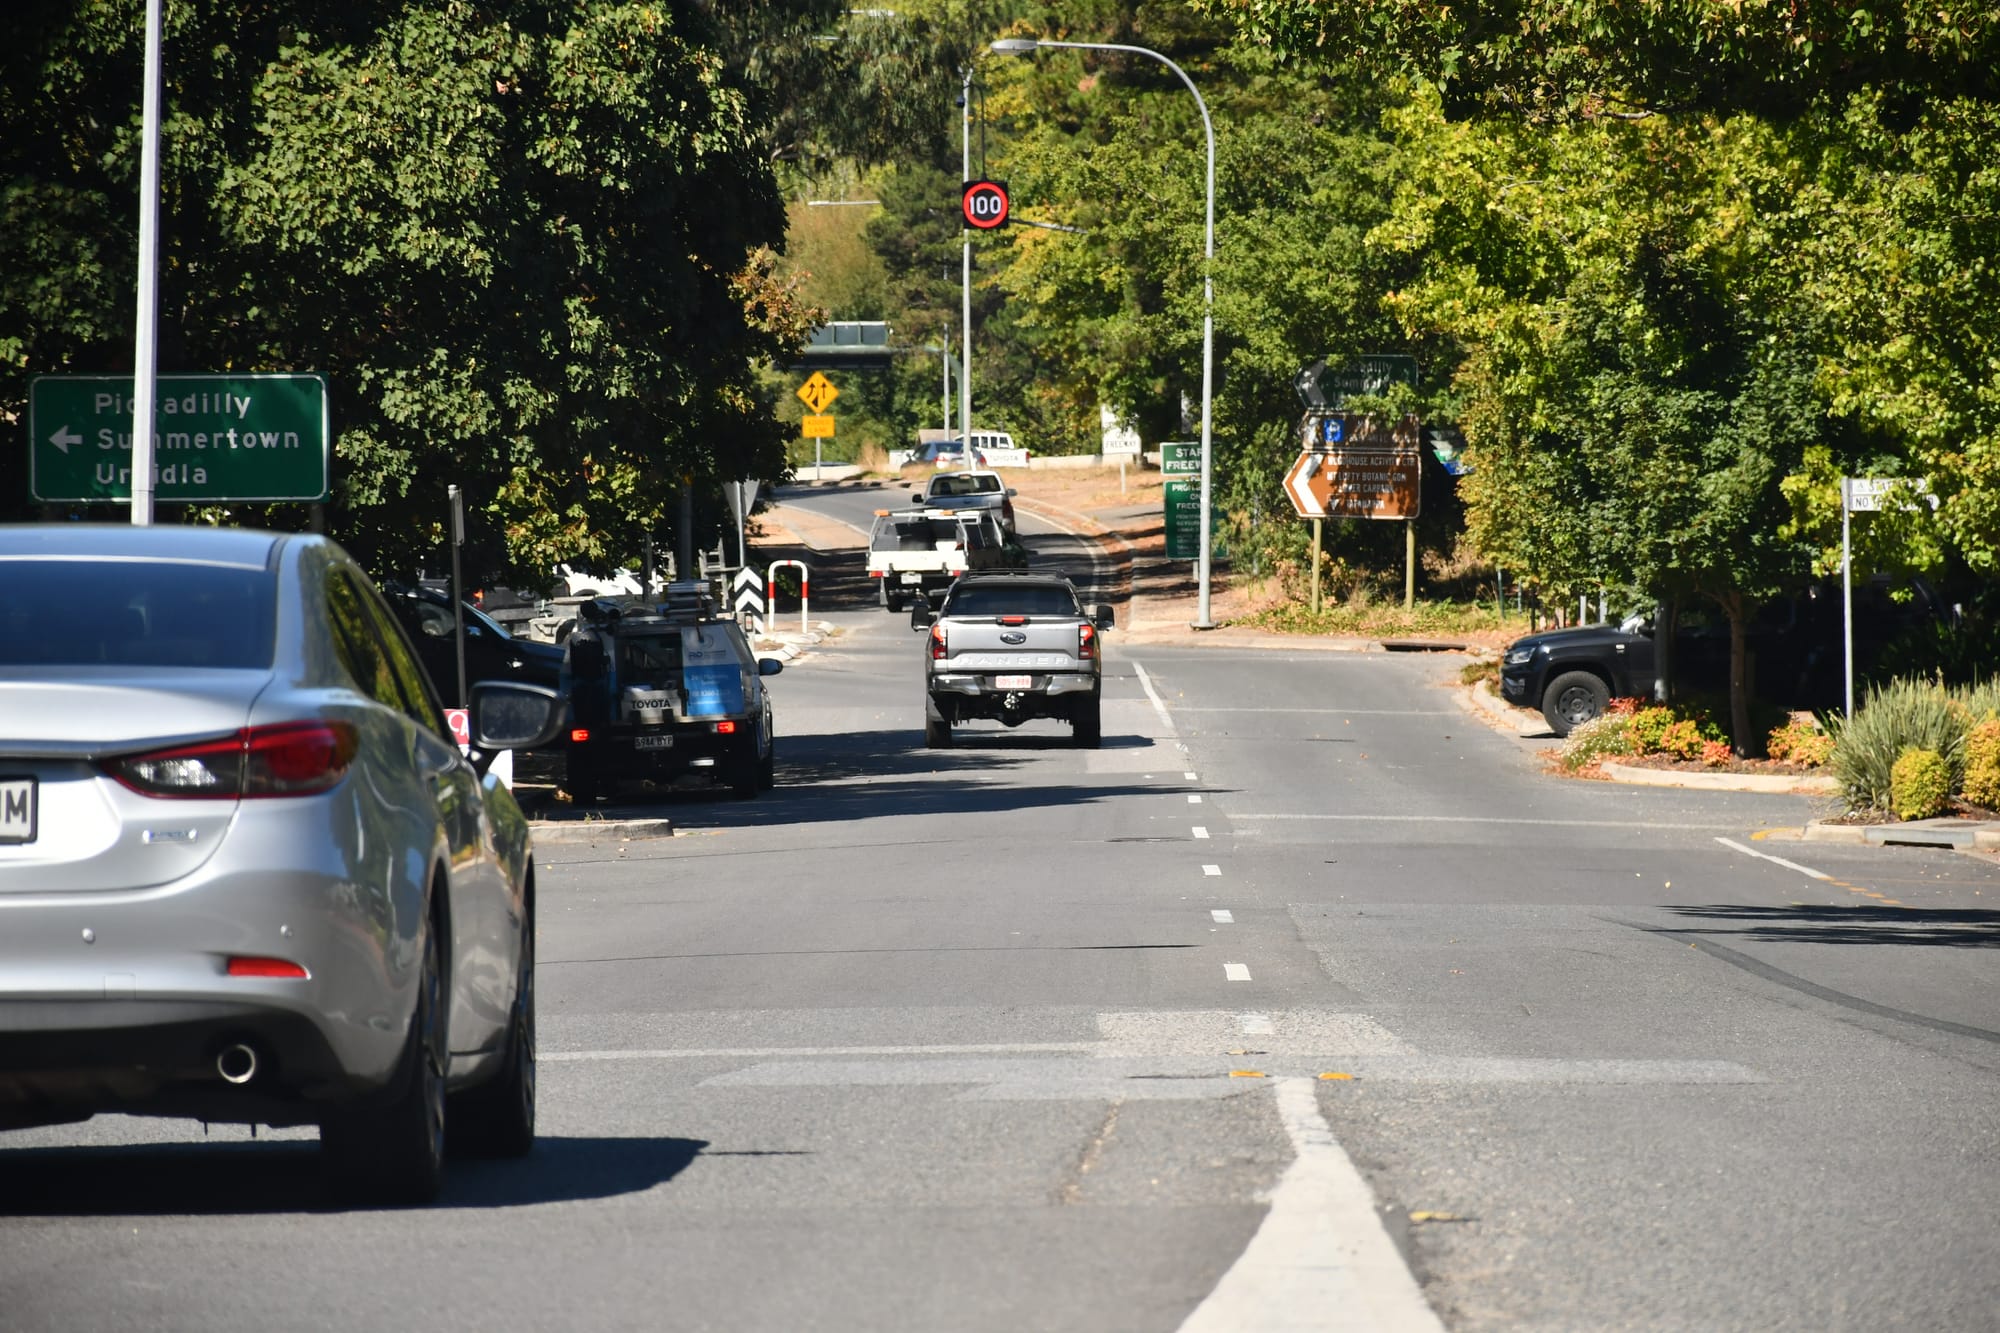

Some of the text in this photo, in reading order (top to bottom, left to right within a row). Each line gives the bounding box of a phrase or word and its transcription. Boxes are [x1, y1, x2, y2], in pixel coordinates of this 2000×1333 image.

[970, 195, 1002, 215] 100
[95, 392, 251, 419] Picadilly
[97, 427, 299, 450] Sumertown
[96, 464, 208, 485] Uridla
[1855, 496, 1869, 507] NO
[959, 656, 1069, 666] RANGER
[632, 698, 671, 709] TOYOTA
[0, 788, 27, 824] M
